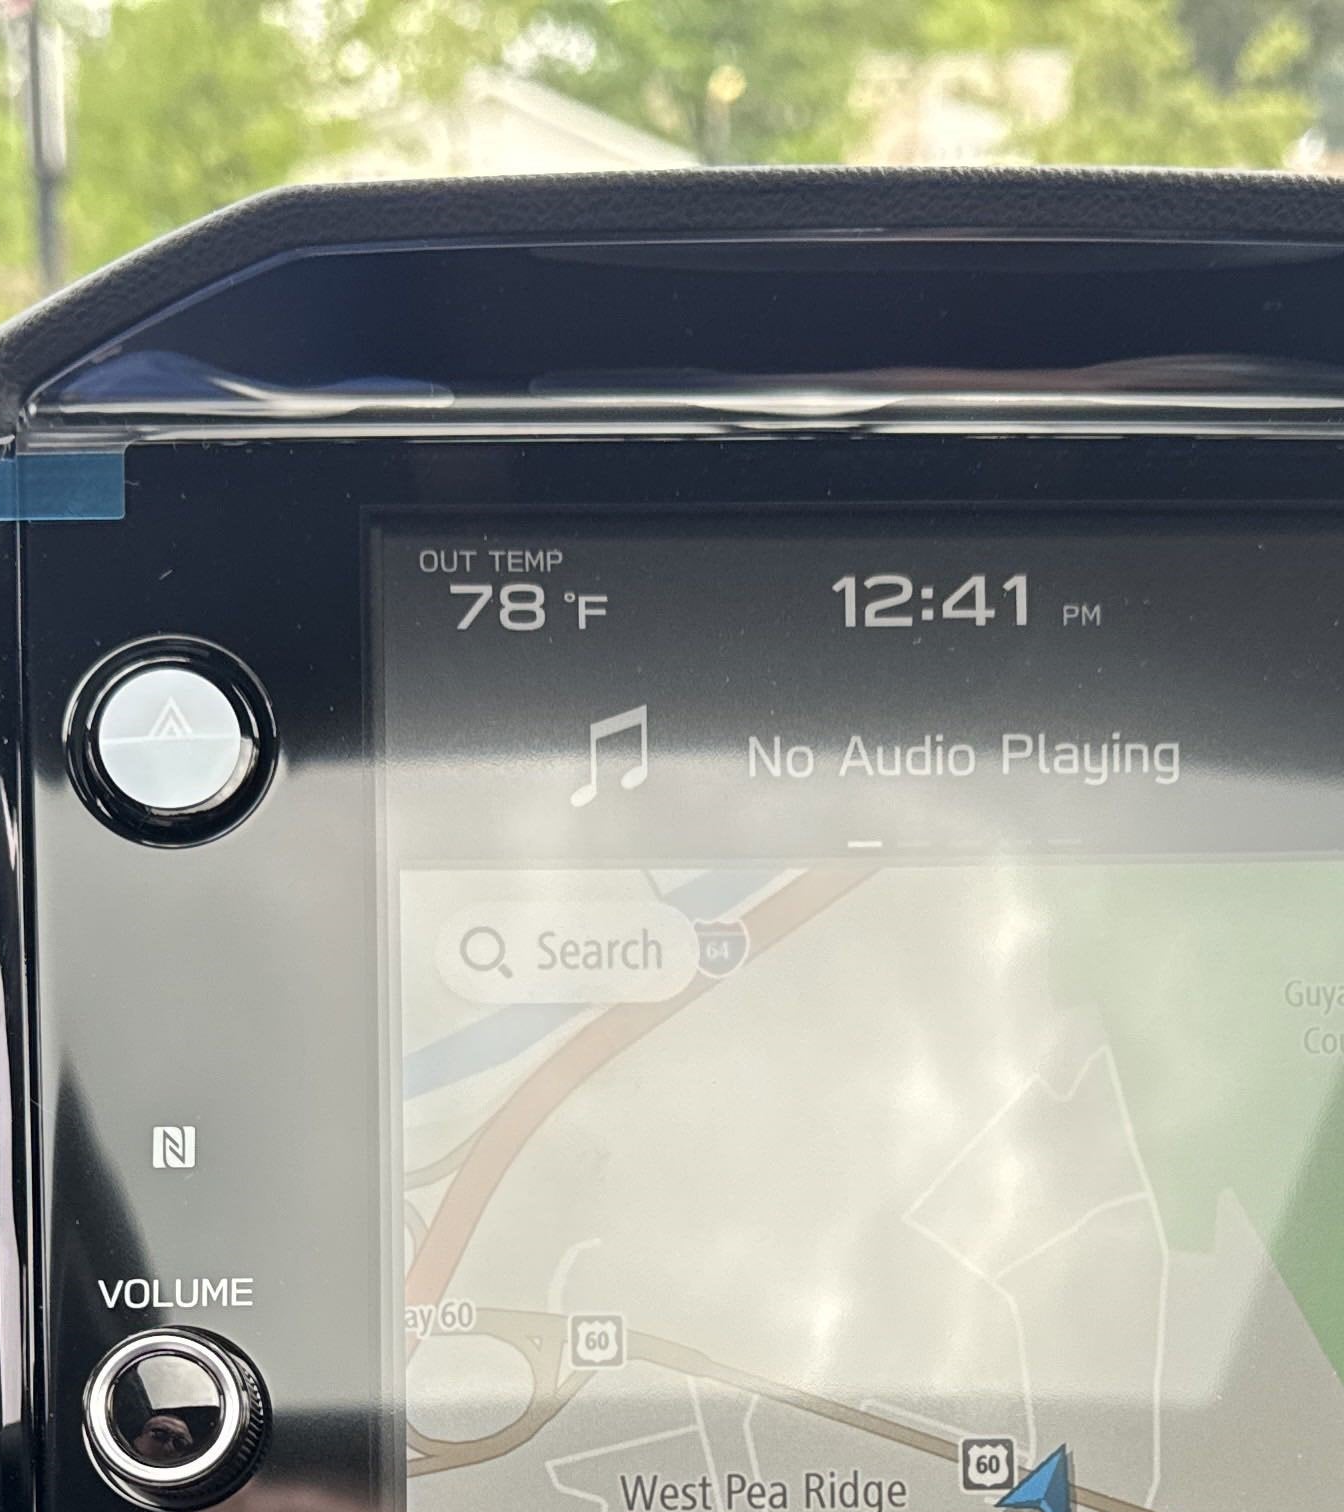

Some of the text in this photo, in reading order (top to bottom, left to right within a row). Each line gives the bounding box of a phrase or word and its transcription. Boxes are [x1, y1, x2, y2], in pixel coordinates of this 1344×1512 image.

[419, 550, 563, 573] OUT TEMP
[448, 582, 548, 631] 78
[831, 573, 1102, 628] 12:41 PM
[746, 732, 1182, 785] No Audio Playing
[538, 928, 664, 971] Search
[98, 1277, 255, 1308] VOLUME
[441, 1301, 474, 1329] 60
[584, 1330, 610, 1353] 60
[975, 1454, 1001, 1476] 60
[619, 1473, 713, 1512] West
[725, 1473, 789, 1510] Pea
